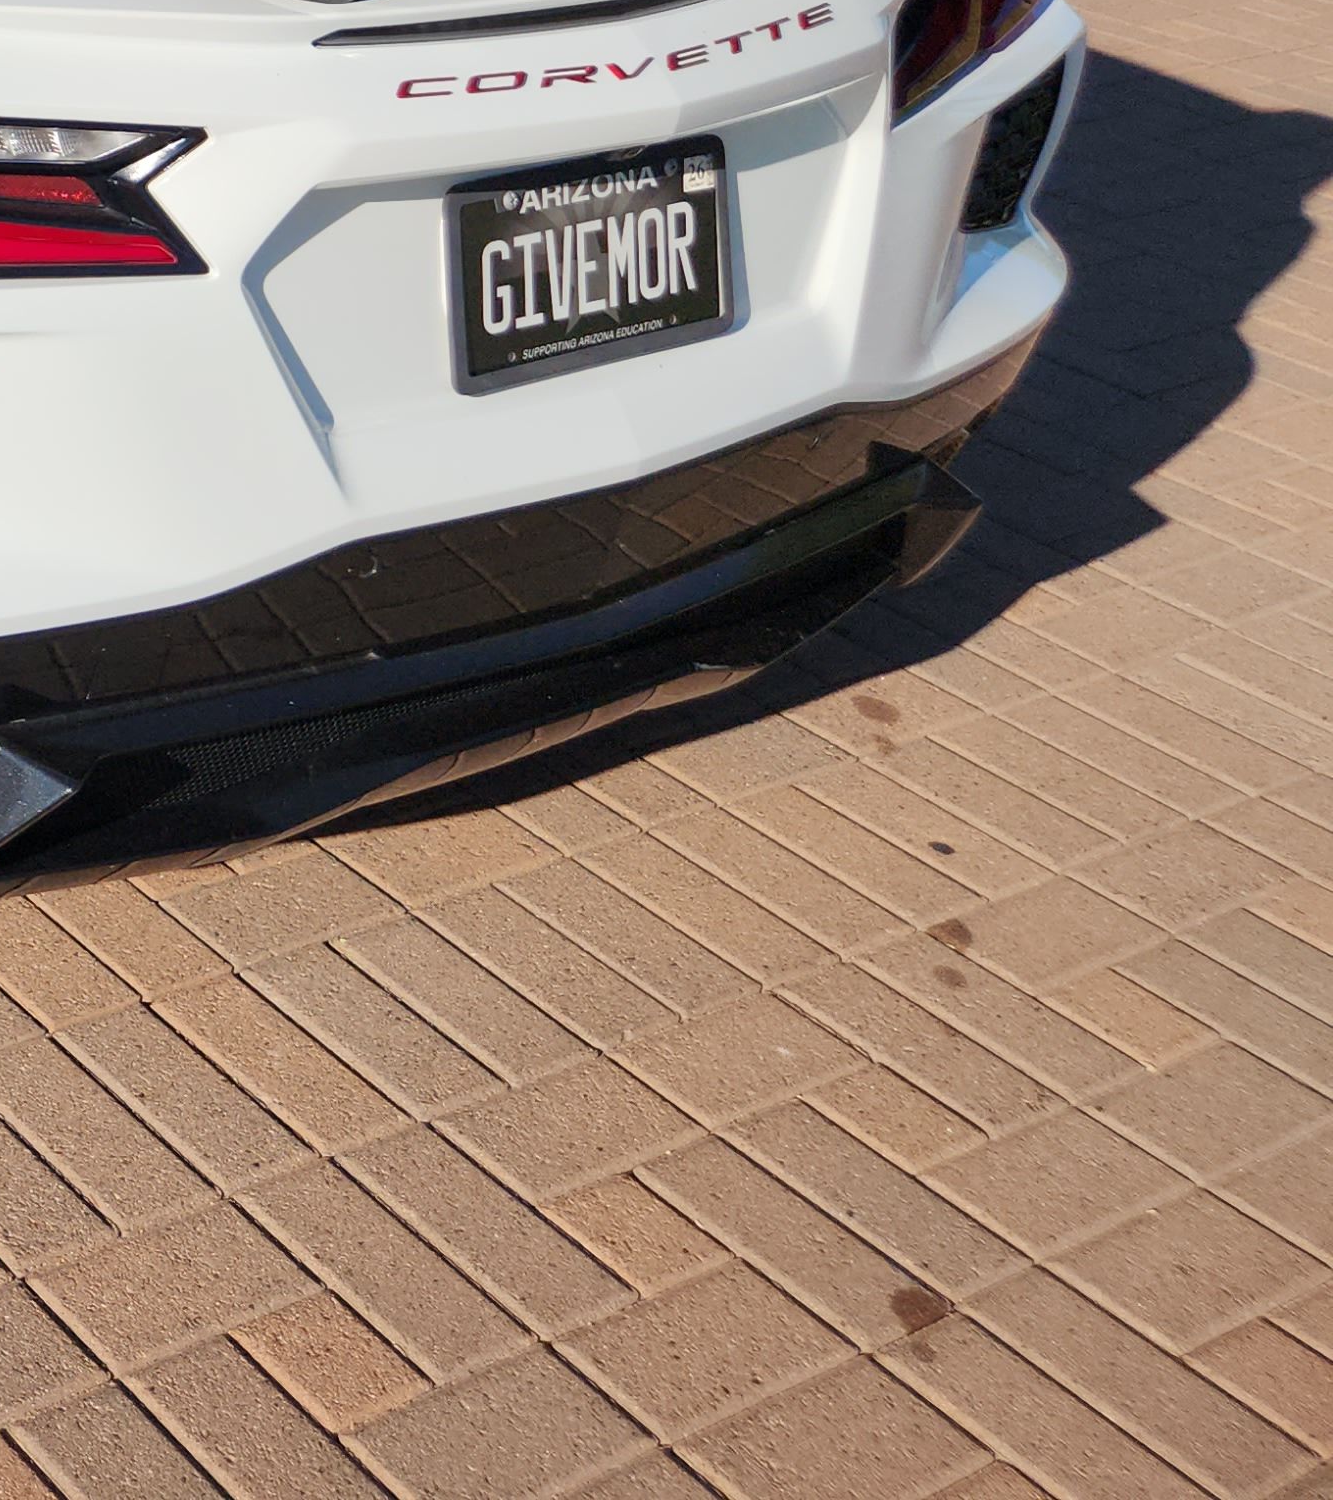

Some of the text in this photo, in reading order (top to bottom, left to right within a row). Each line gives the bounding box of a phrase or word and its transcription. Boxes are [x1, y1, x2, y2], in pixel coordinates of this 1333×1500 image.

[396, 2, 834, 98] CORVETTE
[519, 166, 657, 214] ARIZONA
[688, 163, 705, 182] 26
[481, 201, 697, 335] GIVEMOR
[522, 318, 663, 360] SUPPORTING ARIZONA EDUCATION
